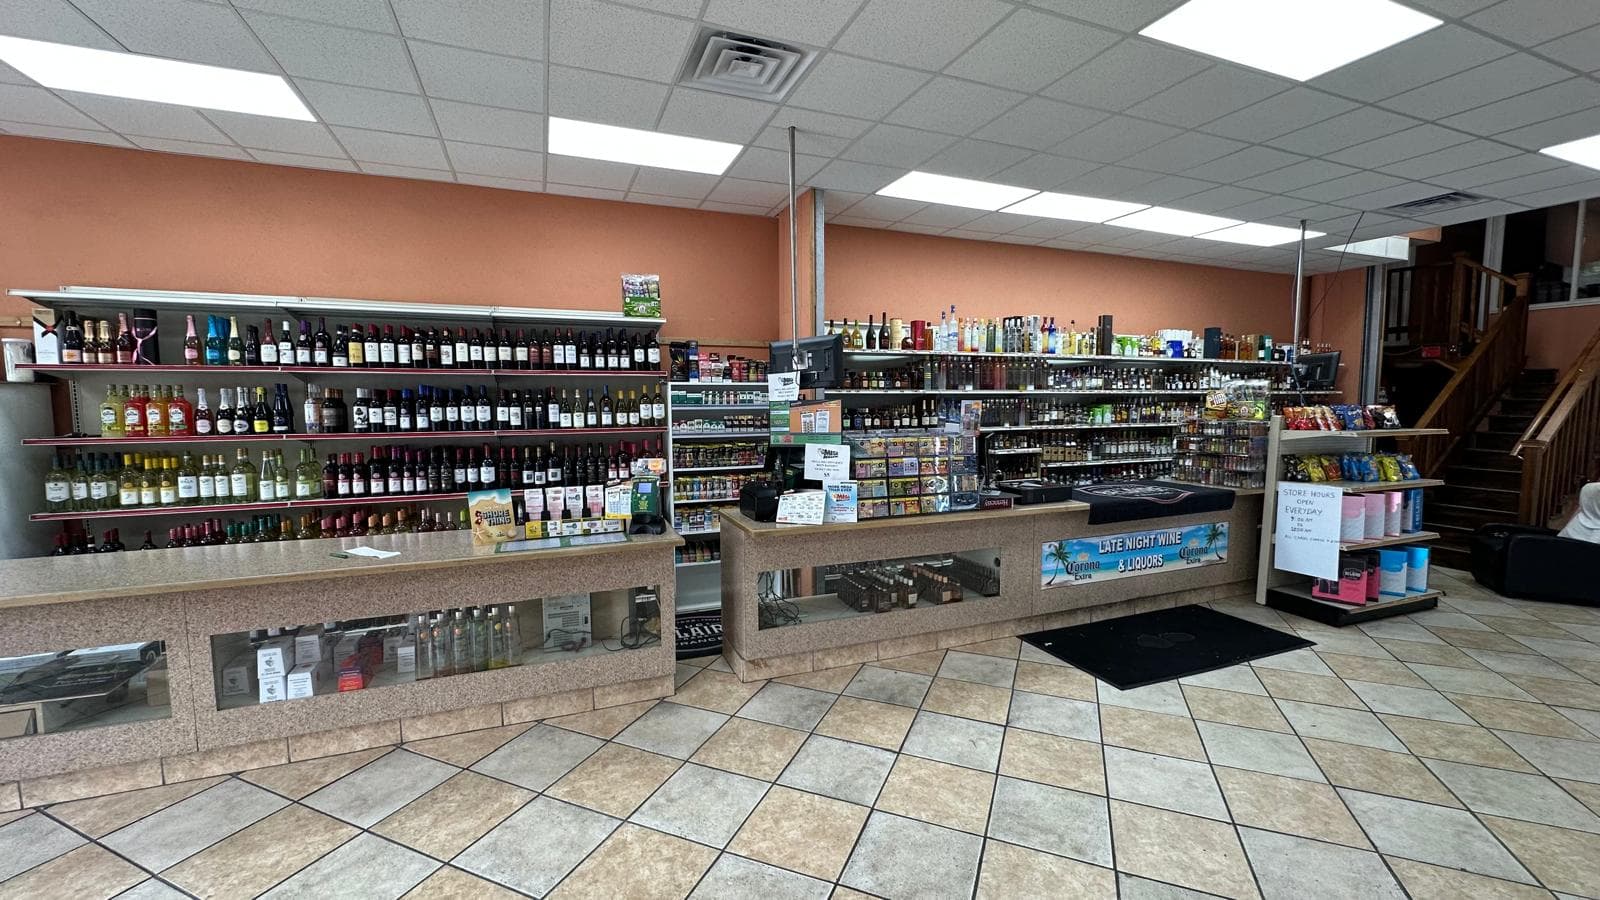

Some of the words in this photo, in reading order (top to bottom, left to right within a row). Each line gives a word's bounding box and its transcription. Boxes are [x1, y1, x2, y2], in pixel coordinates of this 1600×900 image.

[1283, 489, 1307, 497] STORE
[1311, 490, 1335, 498] HOURS
[482, 510, 510, 519] SHORE
[1285, 505, 1323, 516] EVERYDAY
[487, 517, 512, 526] THING
[1099, 539, 1123, 554] LATE
[1126, 535, 1156, 551] NIGHT
[1158, 531, 1182, 547] WINE
[1179, 546, 1208, 559] Corona
[1065, 560, 1100, 574] Corona
[1118, 559, 1126, 573] &
[1128, 554, 1164, 571] LIQUORS
[675, 625, 722, 639] LAIR
